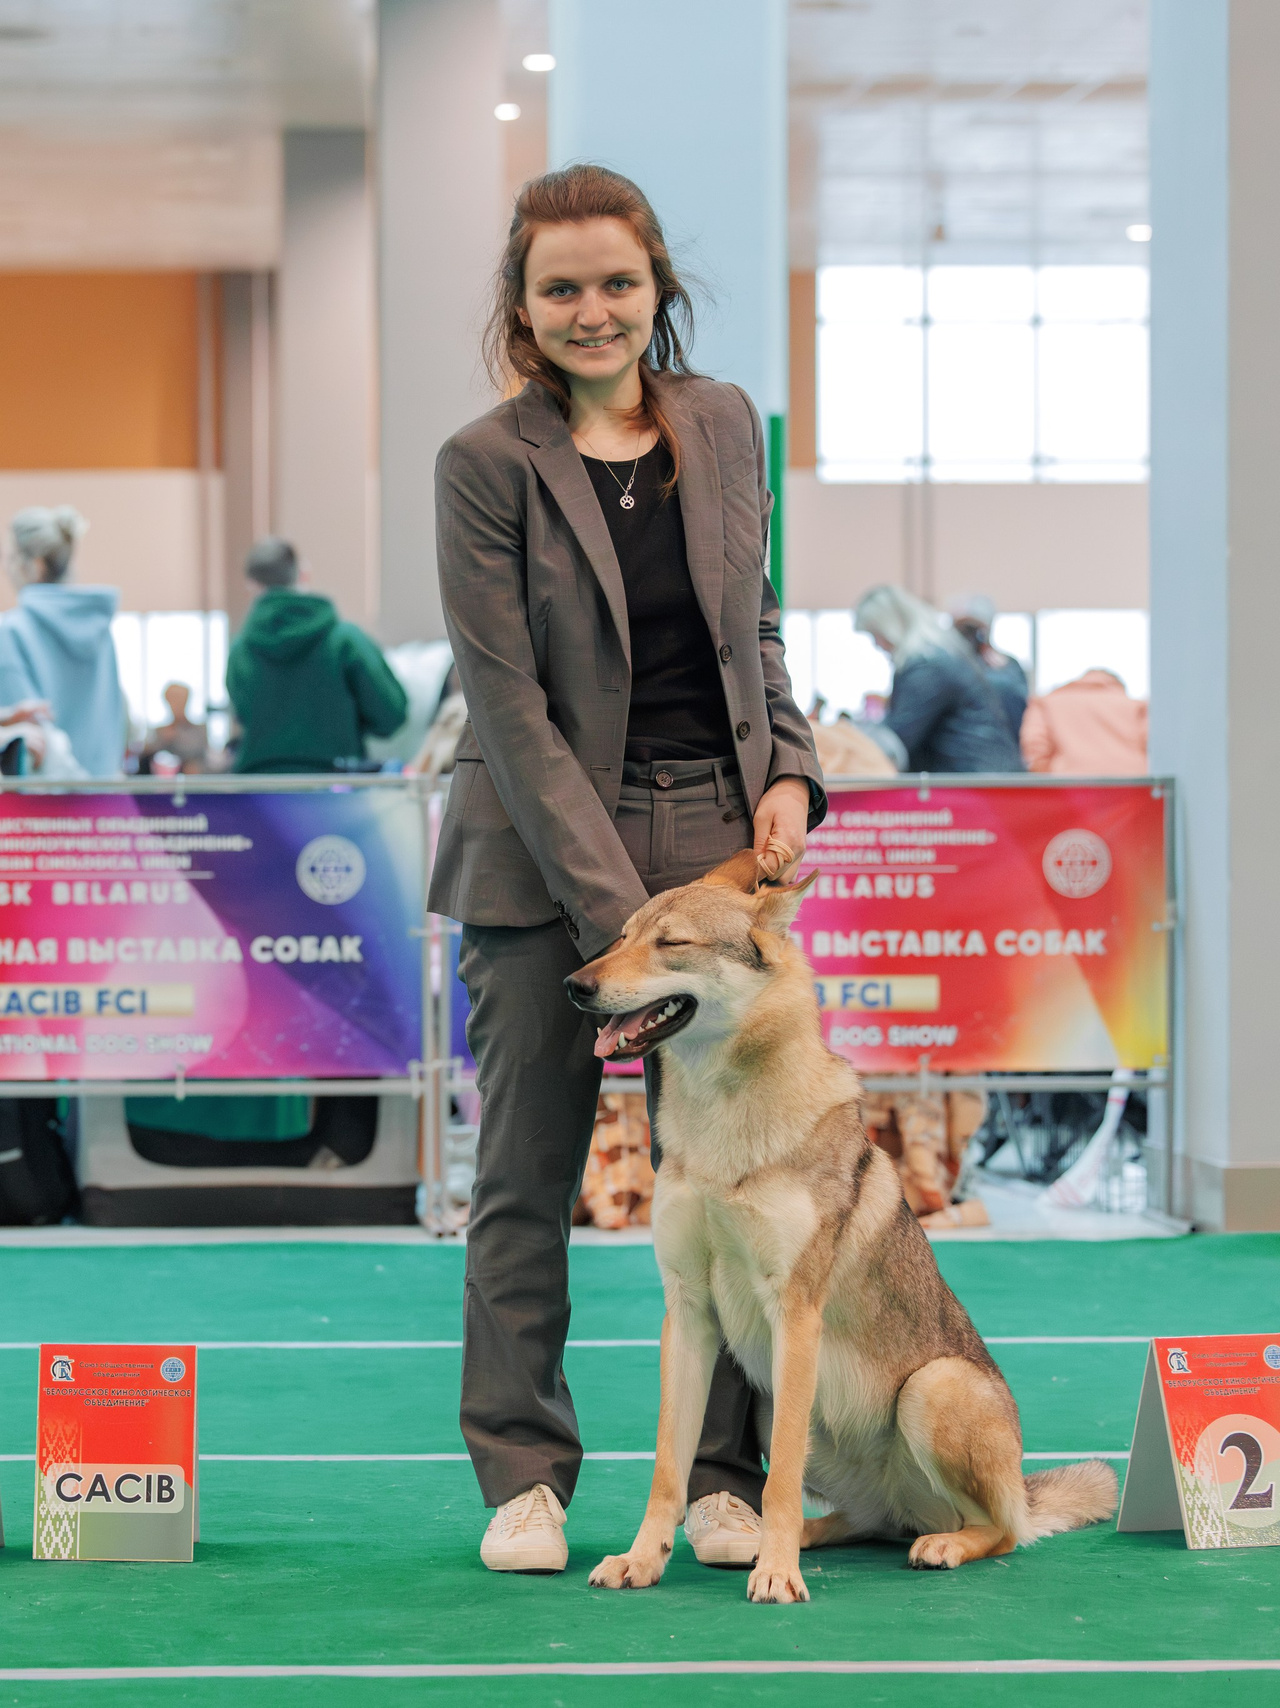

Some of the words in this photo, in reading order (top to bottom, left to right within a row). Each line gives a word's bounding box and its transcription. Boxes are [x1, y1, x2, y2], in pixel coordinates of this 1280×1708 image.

[52, 880, 190, 905] BELARUS
[67, 936, 244, 963] ВЫСТАВКА
[250, 934, 364, 962] СОБАК
[812, 930, 987, 957] ВЫСТАВКА
[994, 929, 1107, 956] СОБАК
[95, 989, 148, 1016] FCI
[841, 982, 892, 1008] FCI
[830, 1025, 883, 1047] DOG
[887, 1025, 958, 1047] SHOW
[111, 1388, 192, 1397] КИНОЛОГИЧЕСКОЕ
[1219, 1431, 1274, 1514] 2
[54, 1471, 176, 1504] CACIB
